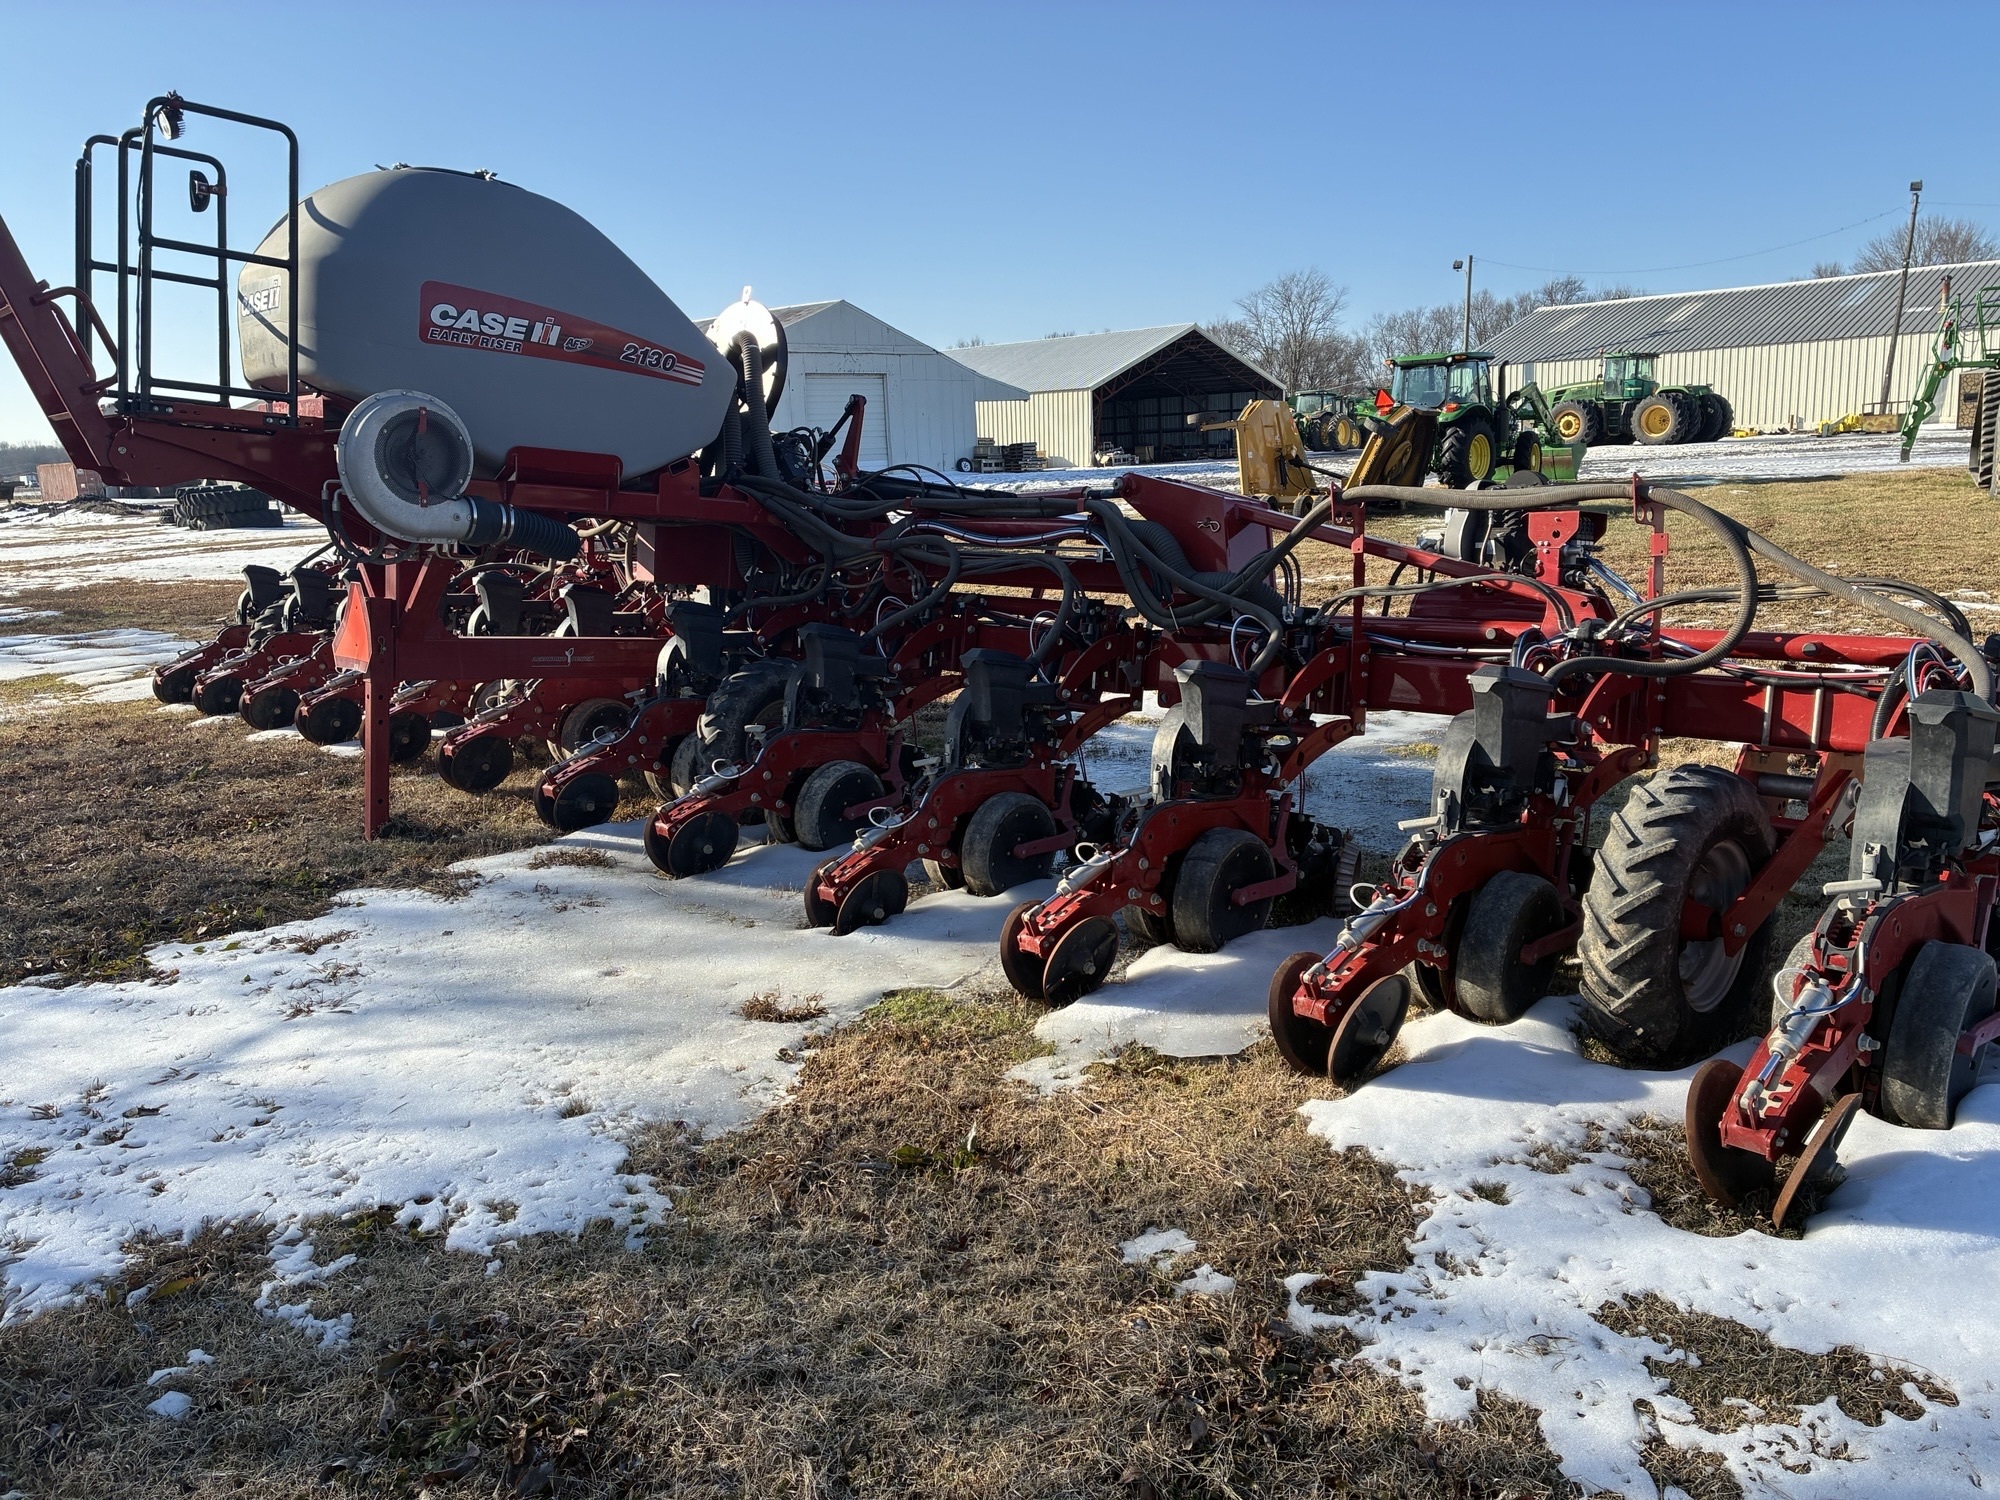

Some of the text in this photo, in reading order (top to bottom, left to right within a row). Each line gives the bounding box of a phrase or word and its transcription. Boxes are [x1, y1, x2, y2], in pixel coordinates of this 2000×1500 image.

[241, 289, 269, 317] CASE
[430, 303, 529, 340] CASE
[428, 327, 523, 354] EARLY RISER
[564, 337, 589, 351] AFS
[620, 342, 678, 372] 2130
